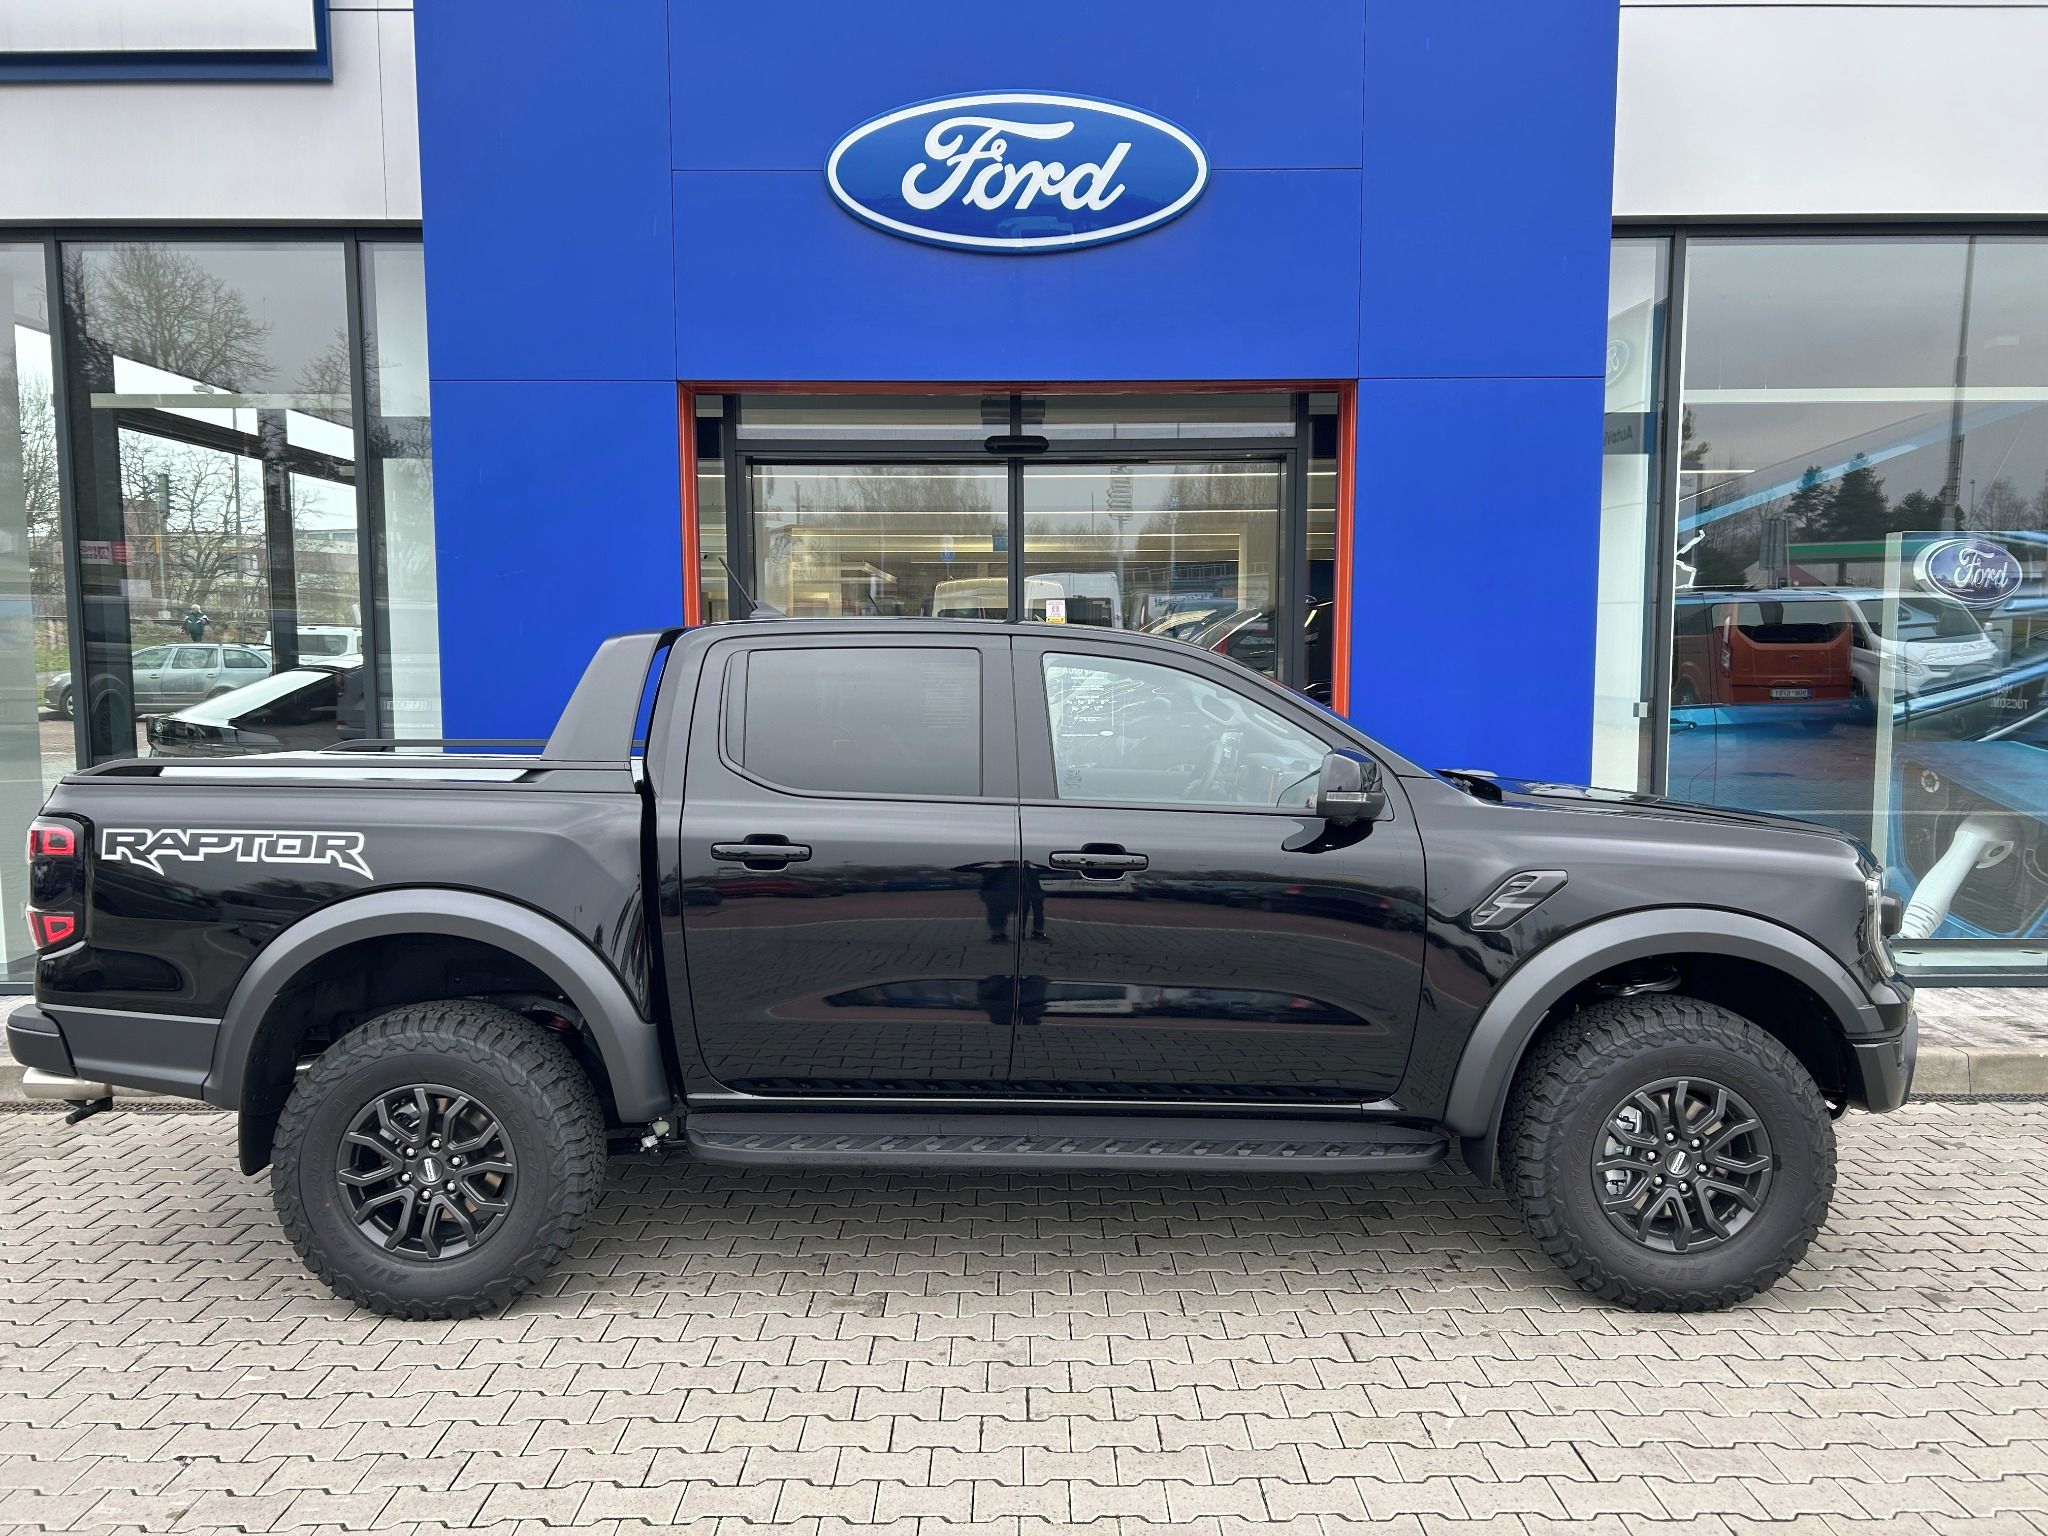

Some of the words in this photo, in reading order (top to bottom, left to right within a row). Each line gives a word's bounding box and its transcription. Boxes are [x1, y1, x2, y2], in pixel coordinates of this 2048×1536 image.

[902, 116, 1132, 211] Ford
[1953, 547, 2009, 589] Ford
[101, 828, 374, 880] RAPTOR
